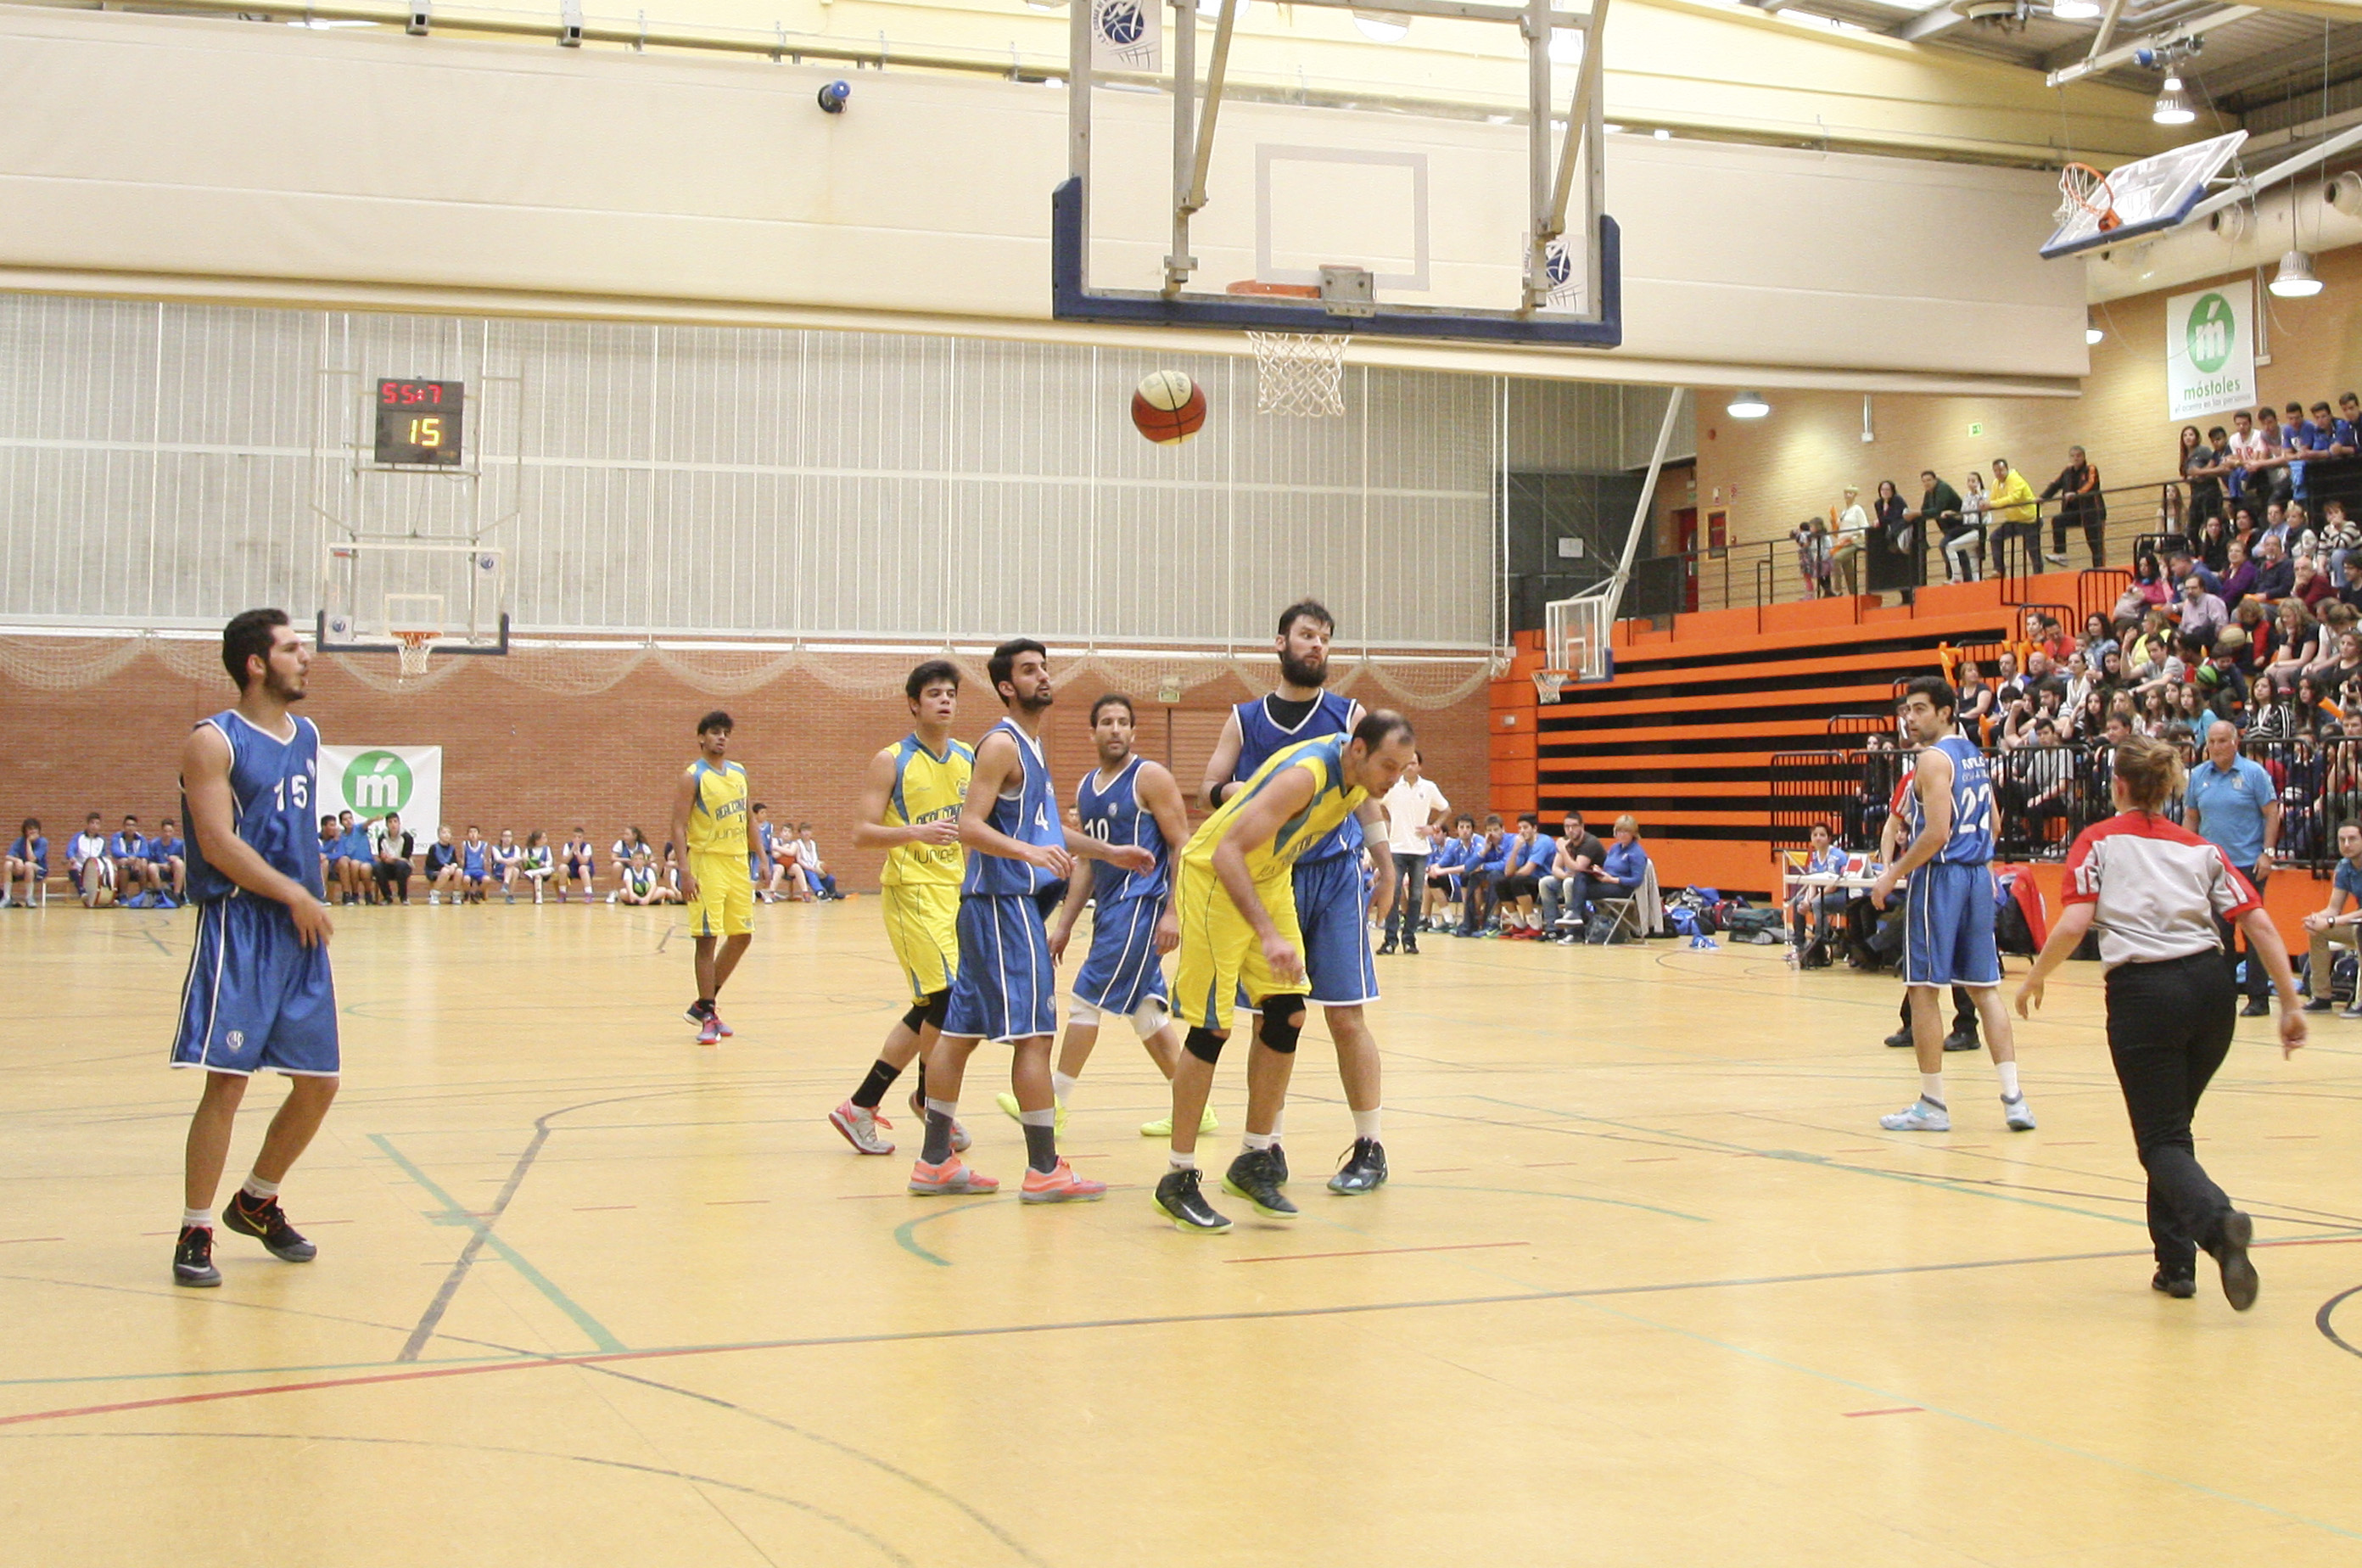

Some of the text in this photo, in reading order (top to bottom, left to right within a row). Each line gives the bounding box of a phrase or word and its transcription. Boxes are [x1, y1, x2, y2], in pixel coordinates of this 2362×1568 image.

[2184, 376, 2241, 401] móstoles
[410, 417, 439, 446] 15
[274, 775, 309, 812] 15
[1958, 782, 1991, 834] 22
[1034, 802, 1049, 832] 4
[1084, 817, 1110, 843] 10
